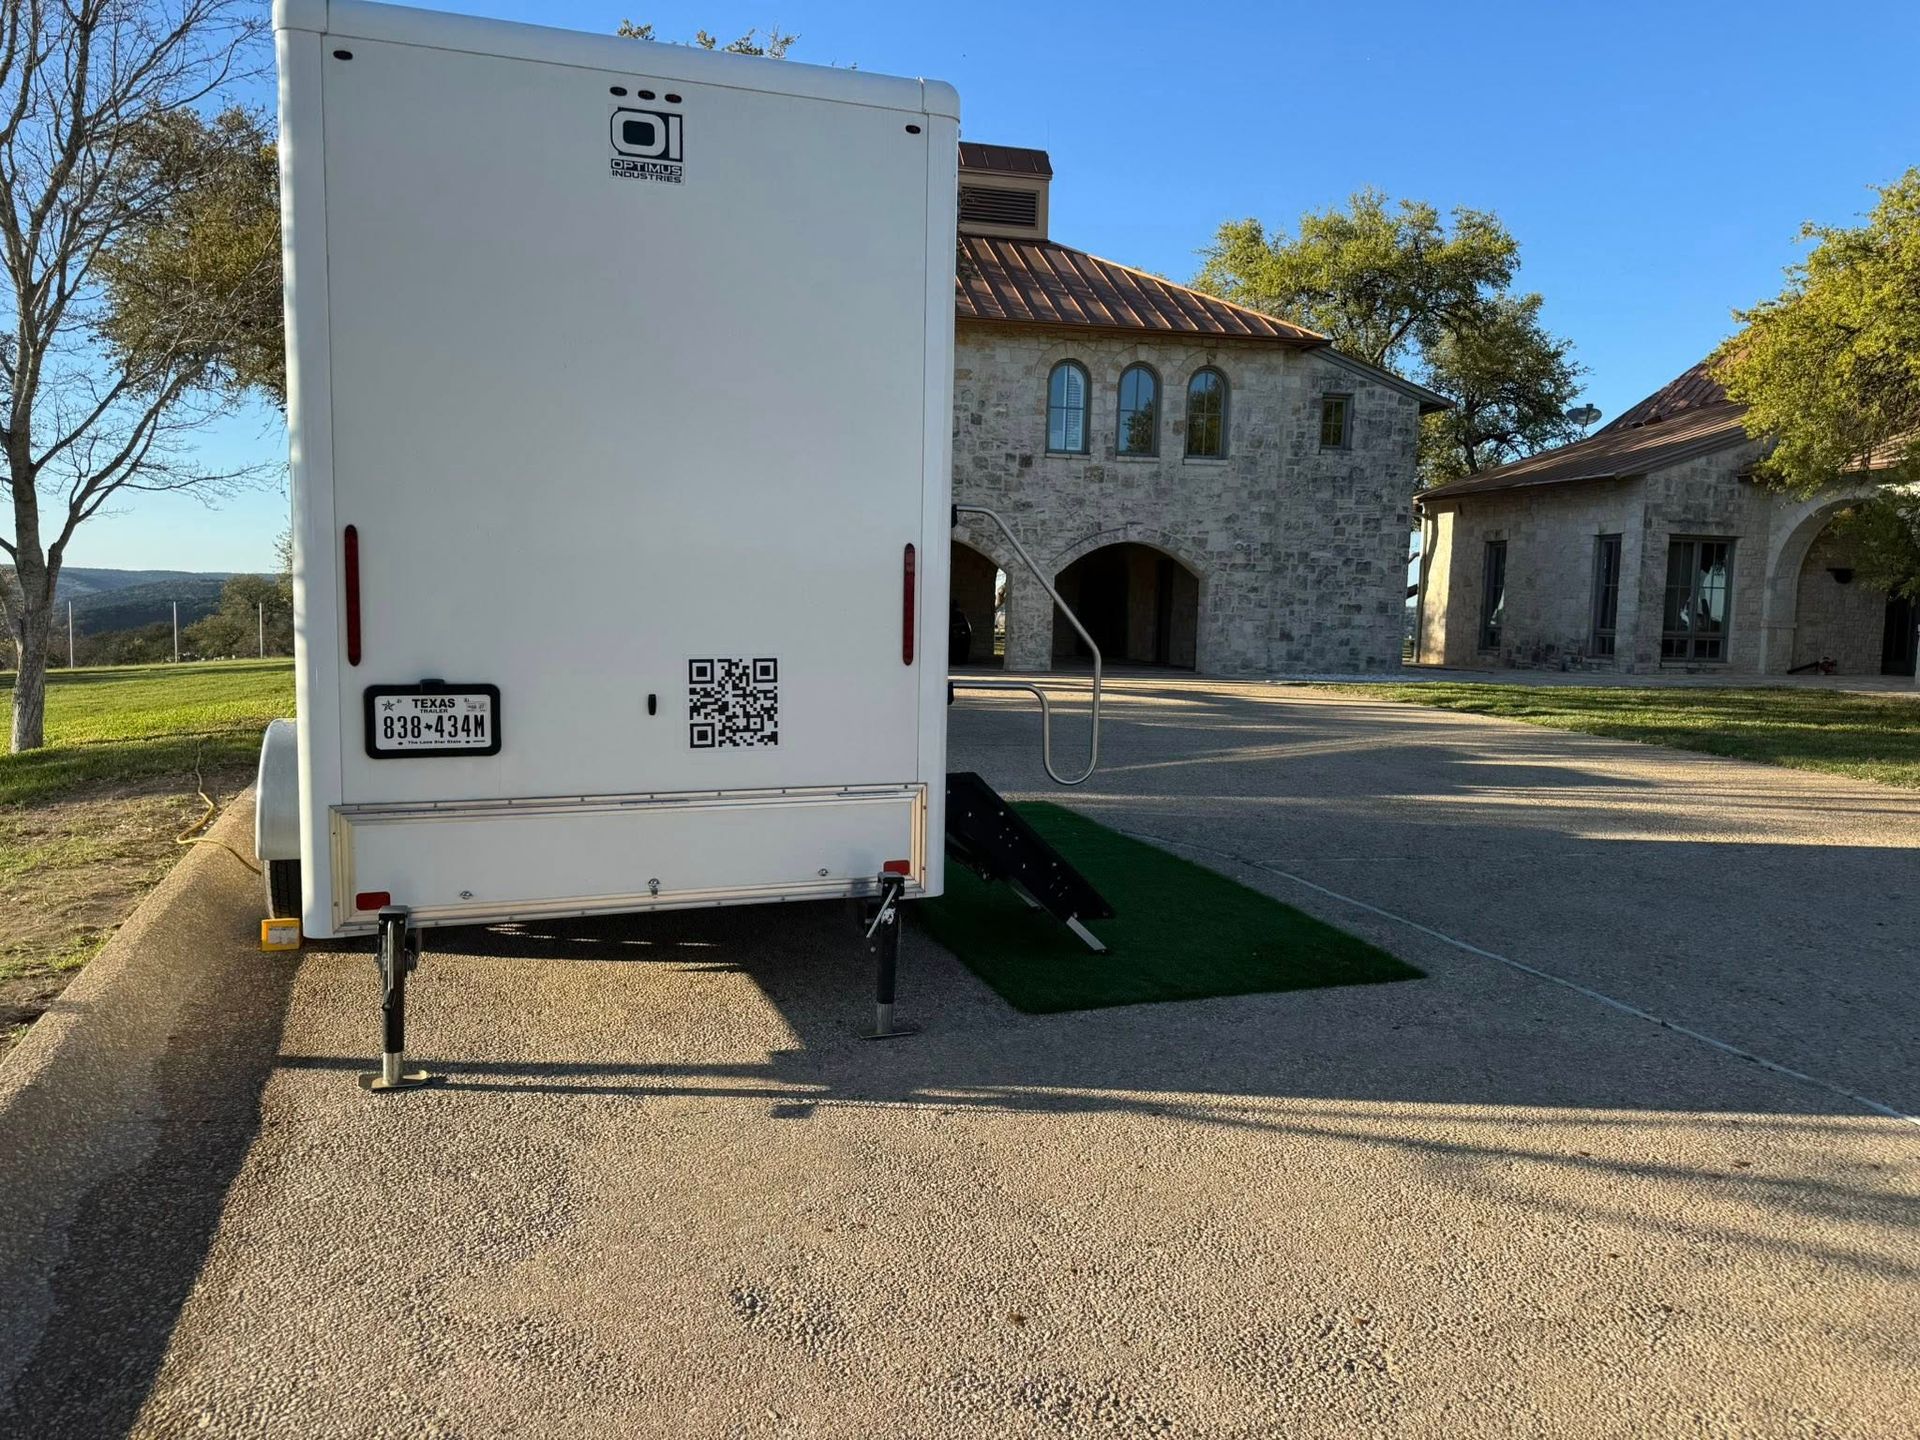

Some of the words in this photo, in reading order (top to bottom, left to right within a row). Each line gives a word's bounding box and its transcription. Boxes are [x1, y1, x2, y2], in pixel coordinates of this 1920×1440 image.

[611, 159, 682, 176] OPTIMUS
[612, 170, 682, 183] INDUSTRIES
[412, 698, 456, 709] TEXAS
